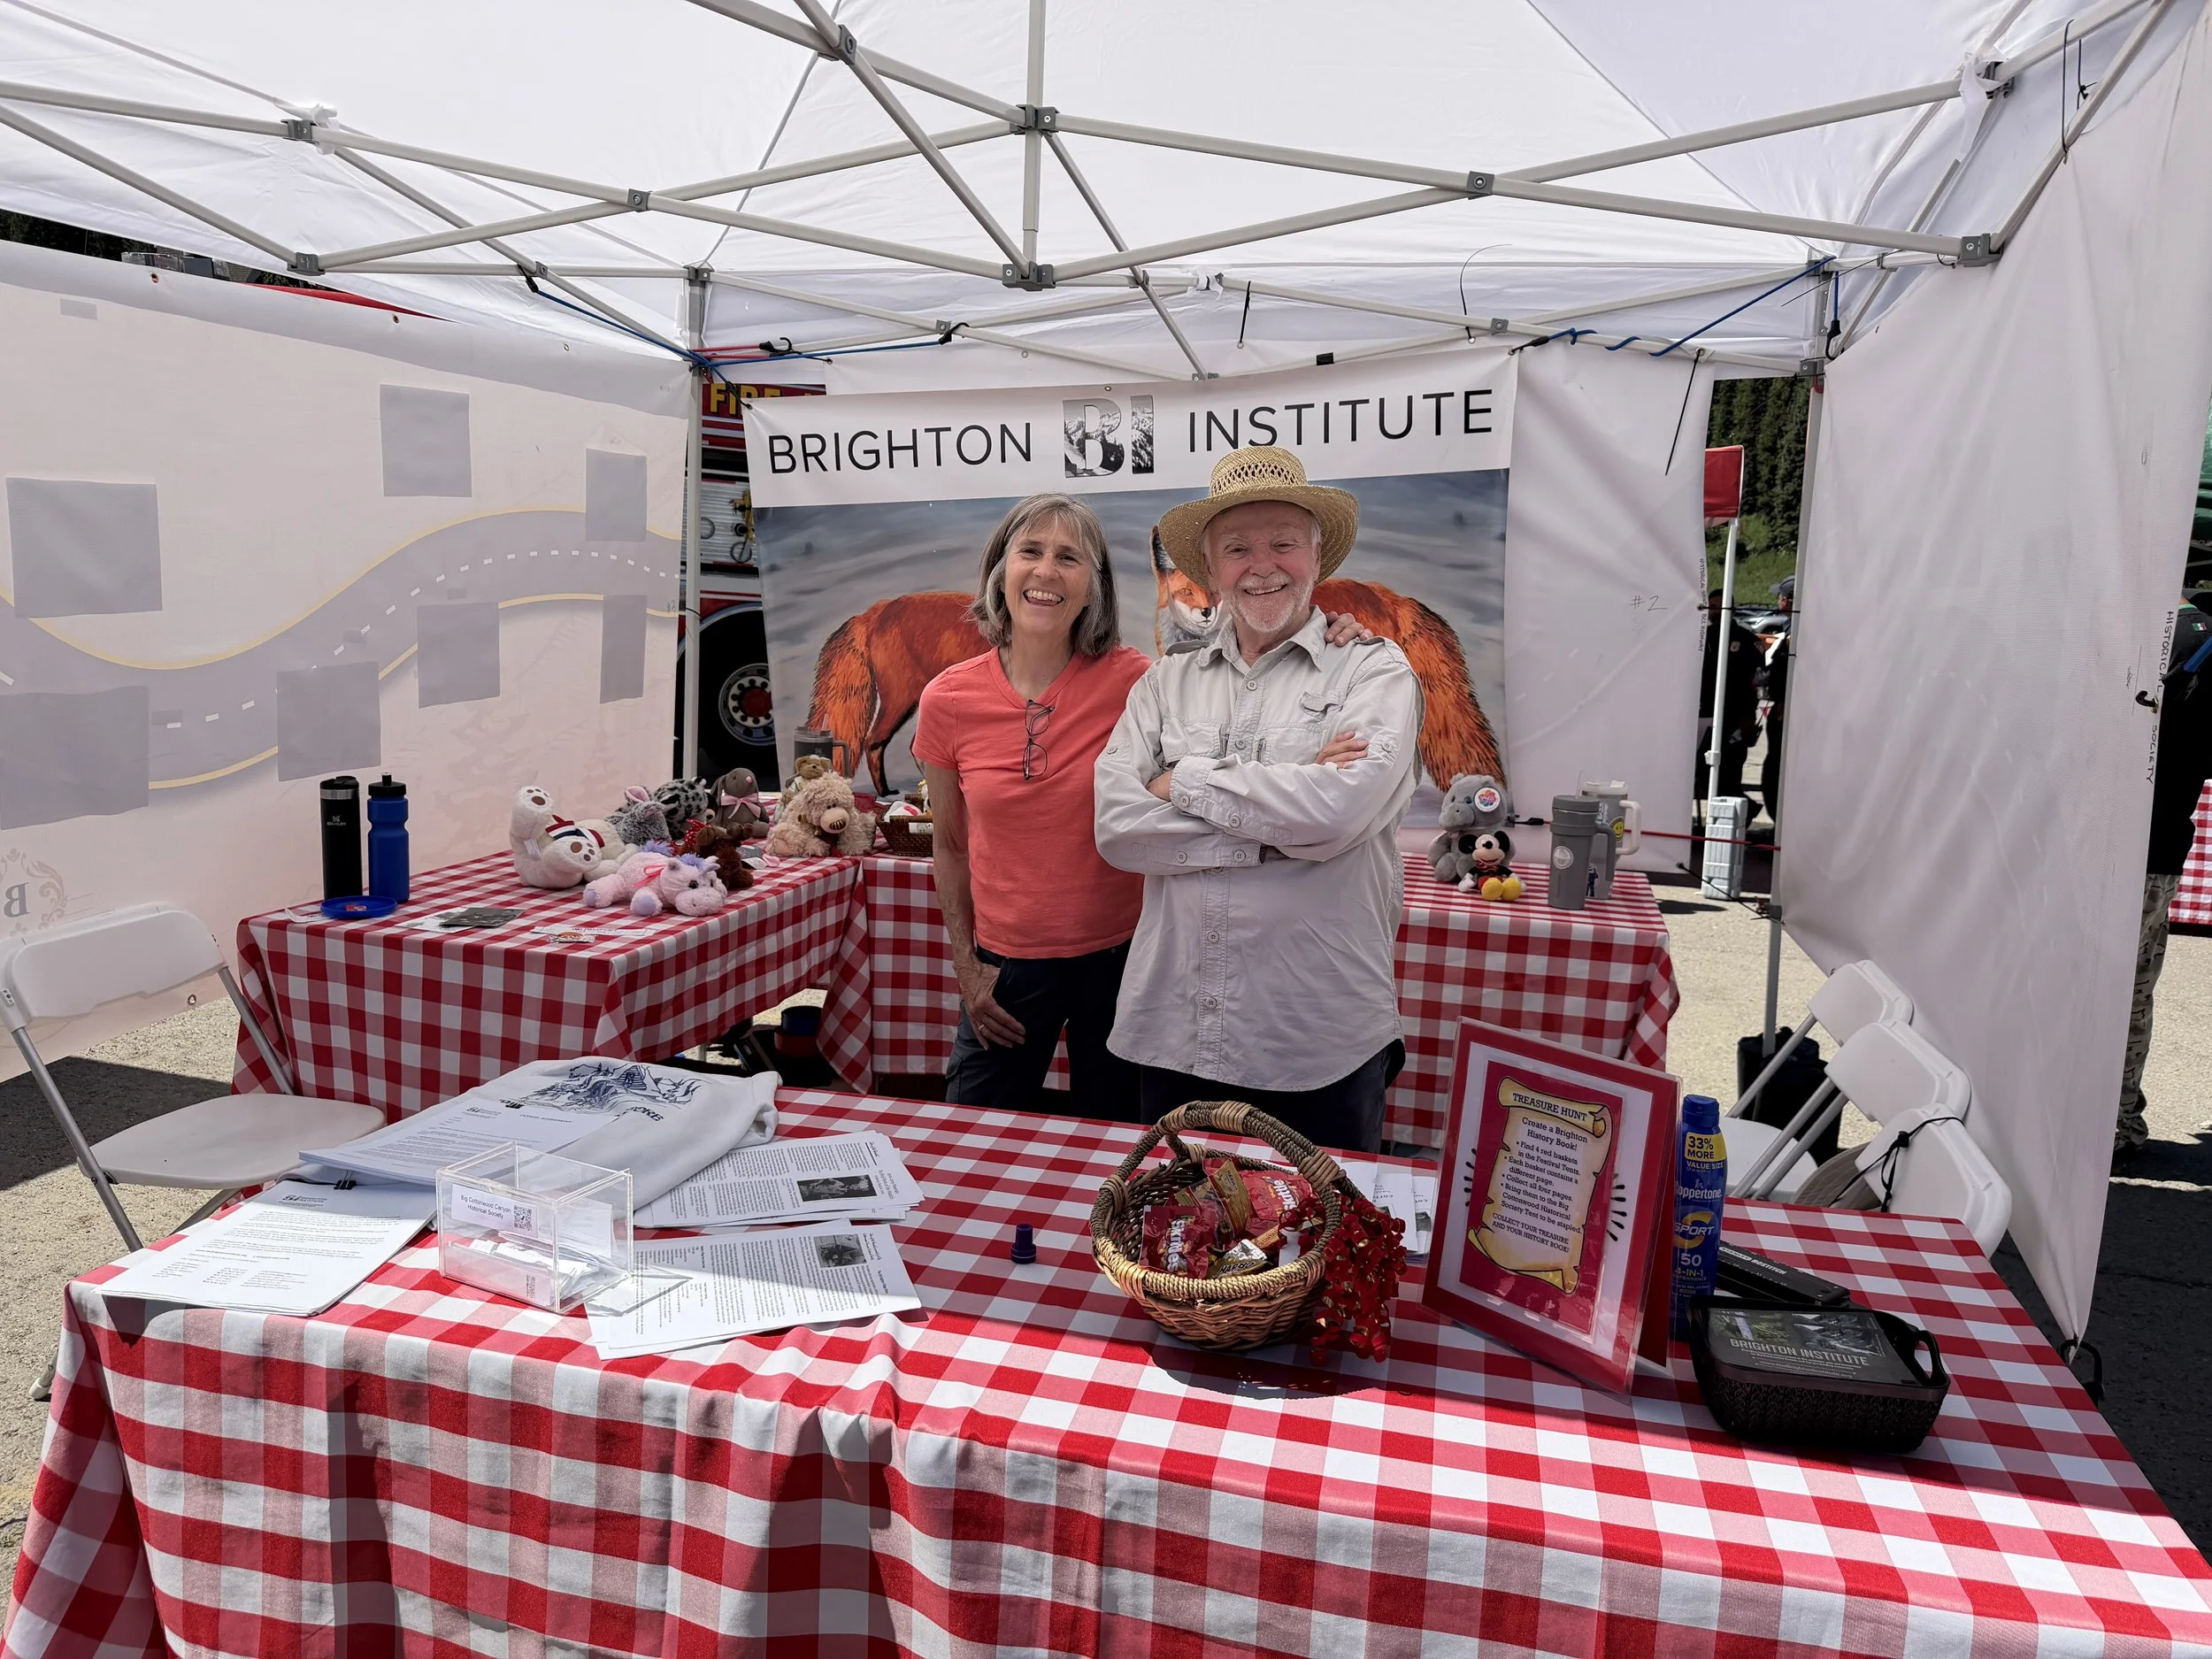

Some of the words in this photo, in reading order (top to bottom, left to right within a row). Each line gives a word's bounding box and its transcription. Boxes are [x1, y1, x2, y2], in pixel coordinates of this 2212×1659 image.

[768, 422, 1032, 474] BRIGHTON
[1063, 395, 1155, 479] BI
[1189, 388, 1493, 453] INSTITUTE
[2156, 611, 2174, 693] HISTORICAL
[2146, 725, 2158, 784] SOCIETY
[1513, 1093, 1559, 1113] TREASURE
[1561, 1107, 1587, 1121] HUNT
[1522, 1117, 1547, 1131] Create
[1556, 1127, 1588, 1143] Brighton
[1527, 1129, 1554, 1144] History
[1556, 1138, 1577, 1151] Book!
[1521, 1142, 1534, 1151] Find
[1541, 1147, 1551, 1156] red
[1554, 1151, 1577, 1164] baskets
[1687, 1149, 1714, 1159] MORE
[1689, 1136, 1713, 1150] 33%
[1509, 1157, 1523, 1167] Each
[1525, 1161, 1545, 1173] basket
[1547, 1169, 1573, 1182] contains
[1509, 1167, 1535, 1180] different
[1536, 1155, 1560, 1169] Festival
[1562, 1164, 1580, 1175] Tents.
[1686, 1161, 1710, 1169] VALUE
[1505, 1183, 1521, 1194] Bring
[1523, 1190, 1538, 1199] them
[1558, 1201, 1569, 1210] Big
[1507, 1175, 1528, 1186] Collect
[1538, 1185, 1550, 1194] four
[1552, 1190, 1573, 1202] pages.
[1675, 1186, 1723, 1201] oppertone
[468, 1204, 487, 1214] Historical
[488, 1209, 504, 1219] Society
[469, 1197, 493, 1208] Cottonwood
[495, 1204, 511, 1214] Canyon
[1501, 1200, 1523, 1214] Society
[1525, 1208, 1538, 1218] Tent
[1557, 1222, 1582, 1234] stapled.
[1503, 1192, 1539, 1210] Cottonwood
[1541, 1205, 1571, 1220] Historical
[1492, 1221, 1505, 1229] AND
[1507, 1225, 1522, 1236] YOUR
[1524, 1232, 1549, 1246] HISTORY
[1550, 1241, 1569, 1253] BOOK!
[1493, 1213, 1519, 1227] COLLECT
[1521, 1222, 1537, 1232] YOUR
[1539, 1228, 1569, 1244] TREASURE
[1675, 1222, 1714, 1235] SPORT
[1167, 1220, 1186, 1272] Skittles
[1680, 1253, 1702, 1266] 50
[1730, 1338, 1797, 1356] BRIGHTON
[1800, 1348, 1870, 1366] INSTITUTE
